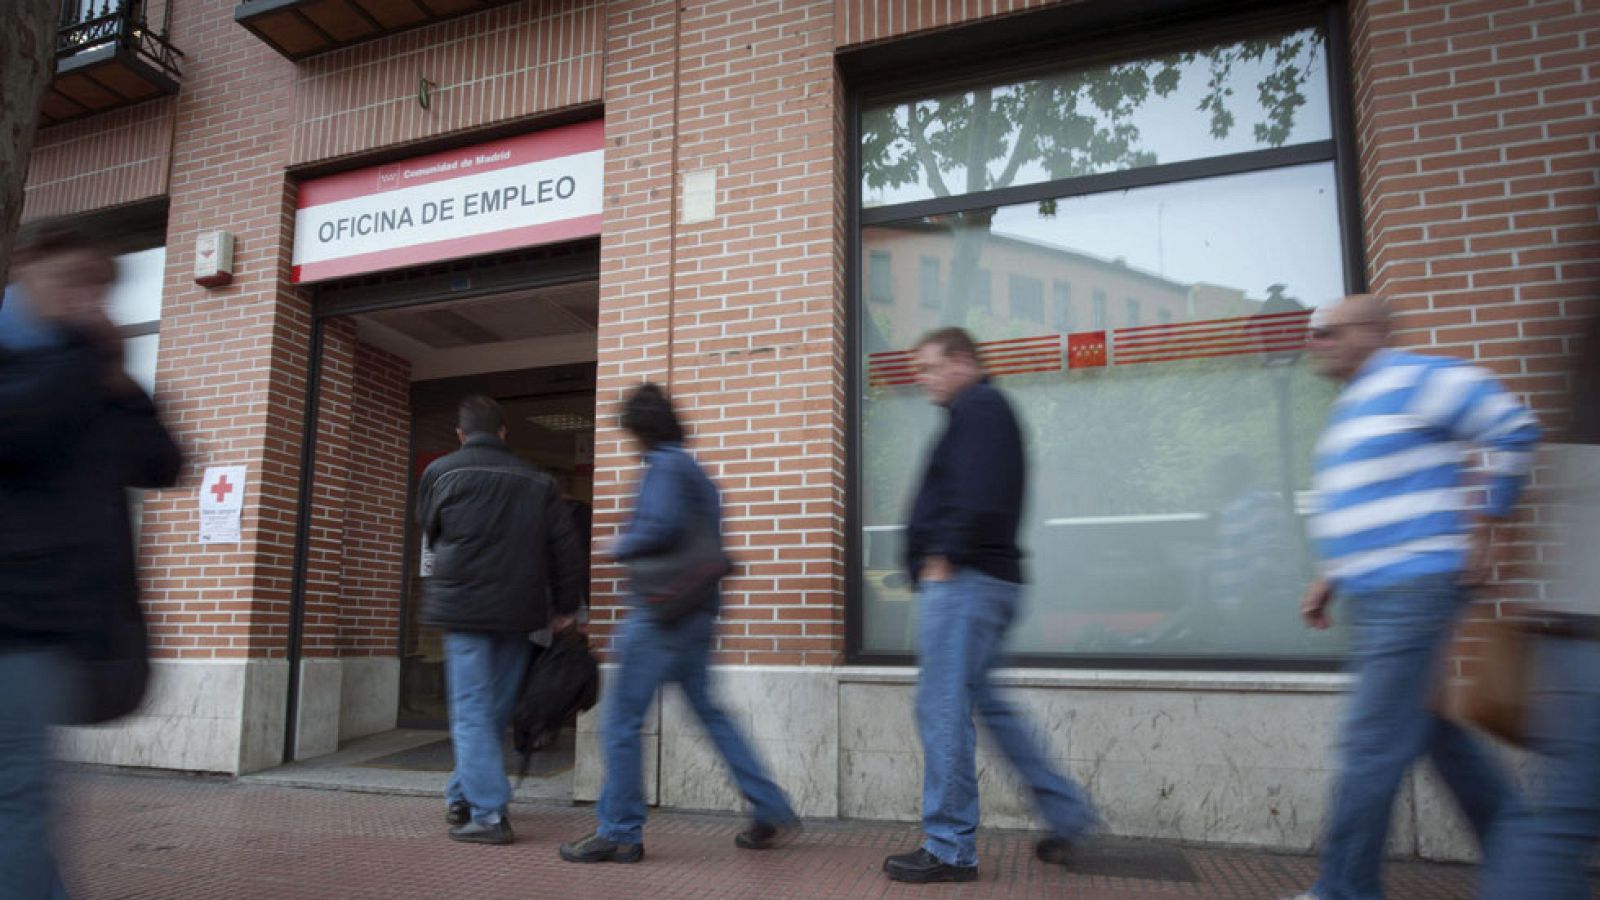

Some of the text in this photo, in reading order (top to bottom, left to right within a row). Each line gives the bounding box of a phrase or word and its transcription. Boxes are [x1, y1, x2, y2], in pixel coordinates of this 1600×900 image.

[403, 150, 511, 179] Comunidad de Madrid
[318, 175, 576, 243] OFICINA DE EMPLEO
